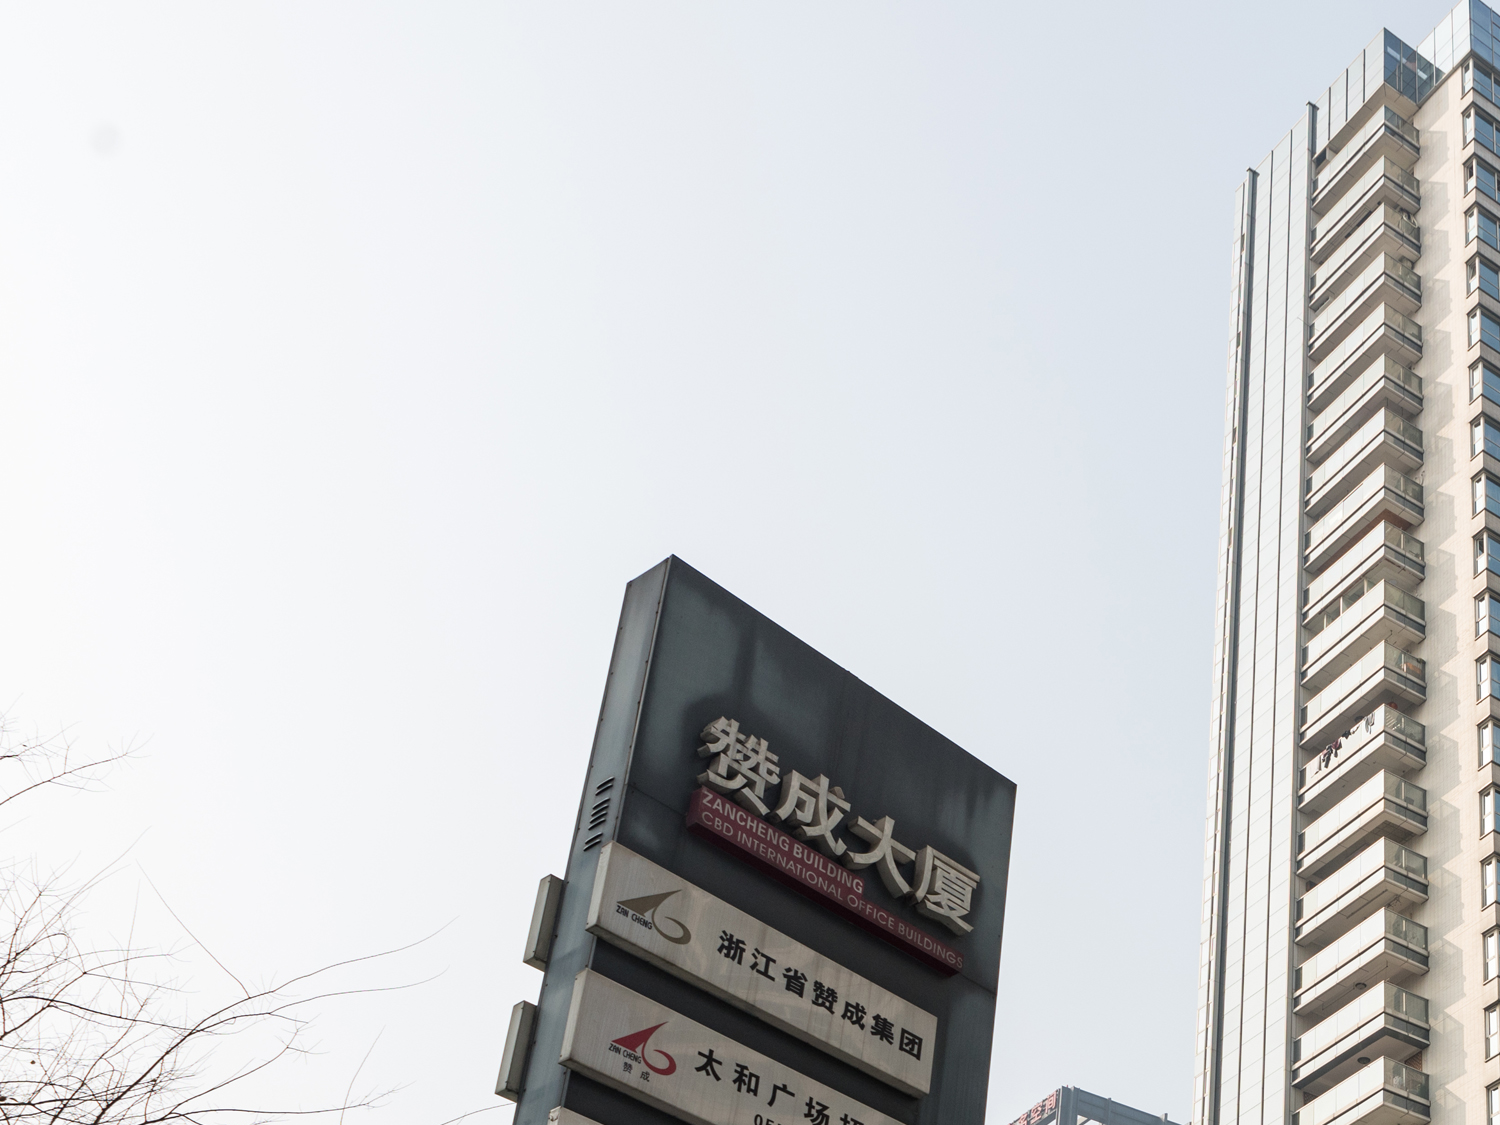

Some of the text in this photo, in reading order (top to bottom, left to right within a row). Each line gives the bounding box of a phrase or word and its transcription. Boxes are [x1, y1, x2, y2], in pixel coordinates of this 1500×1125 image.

[697, 716, 981, 936] 赞成大厦
[702, 790, 864, 894] ZANCHENG BUILDING
[616, 904, 653, 931] ZAN CHENG
[702, 811, 964, 970] CBD INTERNATIONAL OFFICE BUILDINGS
[717, 930, 924, 1061] 浙江省赞成集团
[608, 1043, 642, 1065] ZAN CHENG
[622, 1061, 650, 1083] 赞成
